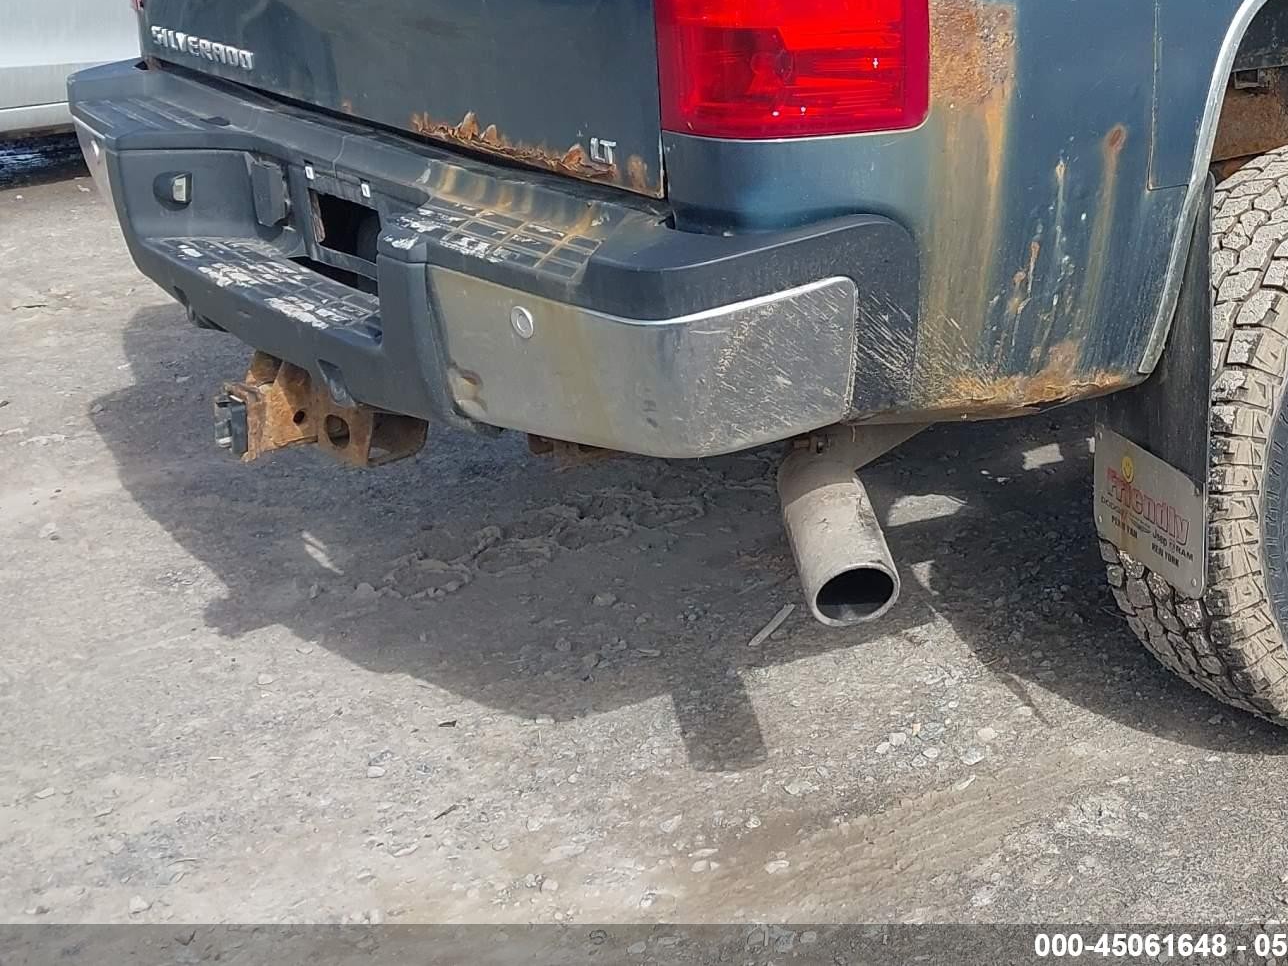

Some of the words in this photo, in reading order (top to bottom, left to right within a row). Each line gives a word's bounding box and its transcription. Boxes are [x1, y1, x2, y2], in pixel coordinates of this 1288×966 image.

[151, 25, 254, 70] SILVERADO
[590, 137, 617, 164] LT
[1106, 467, 1190, 546] Friendly
[1164, 550, 1179, 567] YORK
[1175, 544, 1194, 562] RAM
